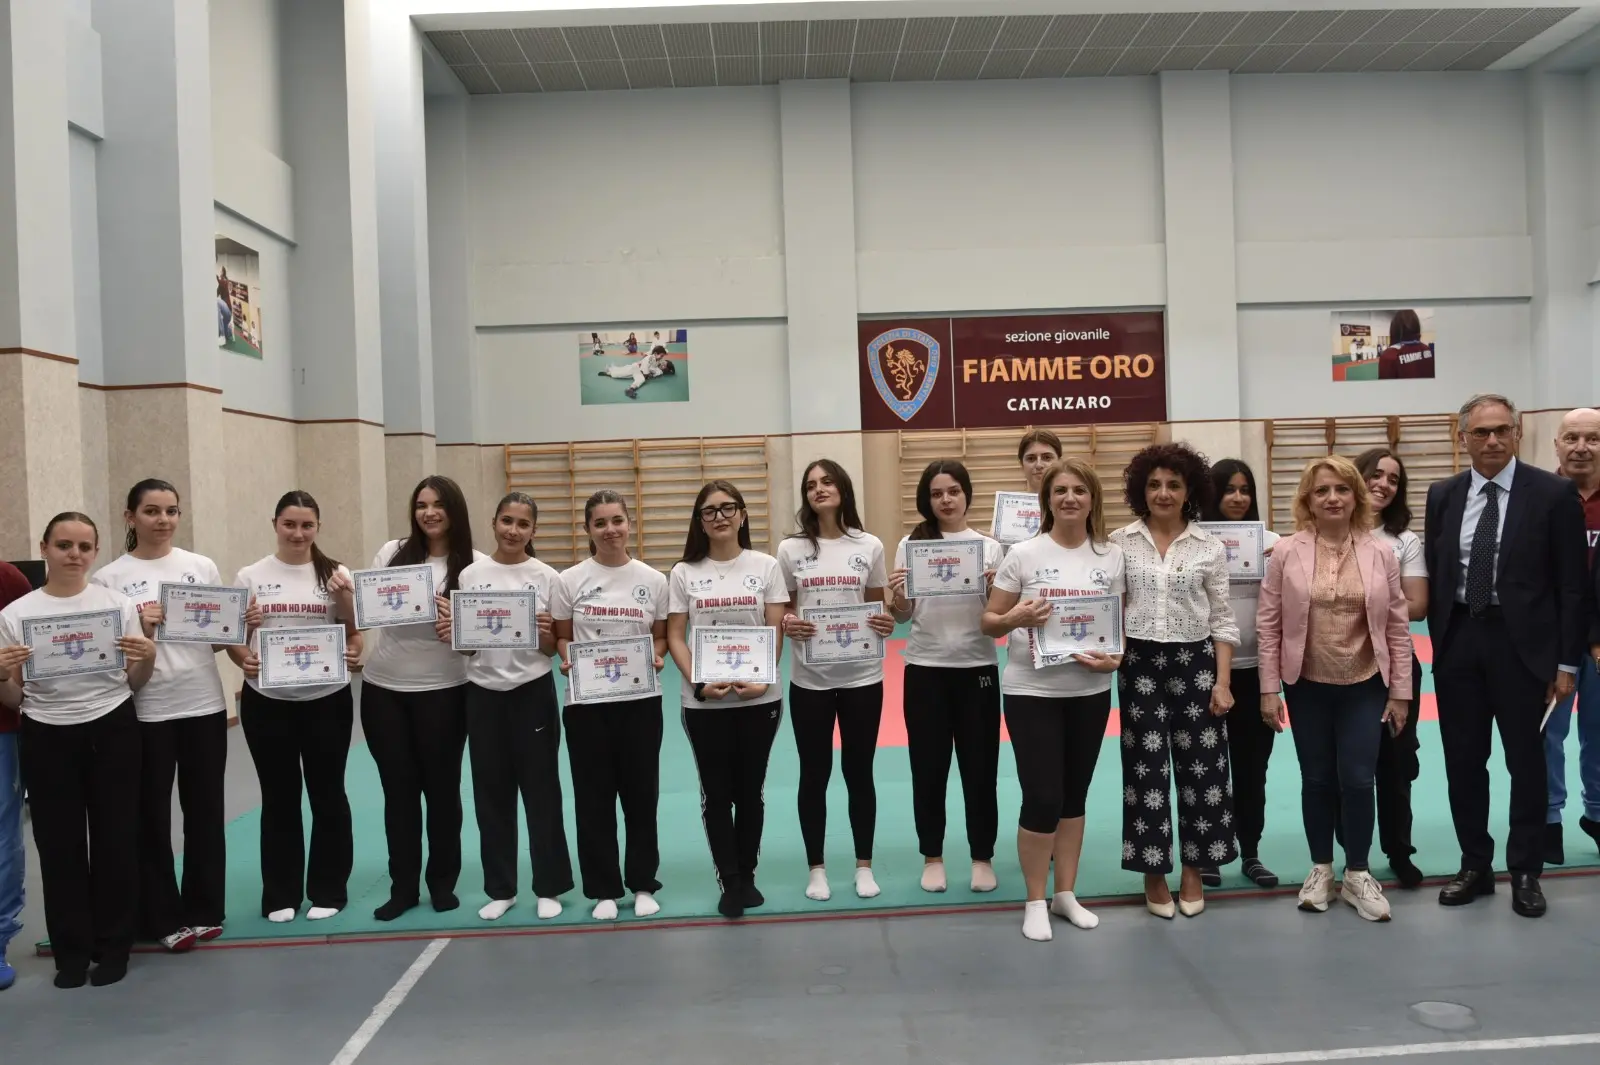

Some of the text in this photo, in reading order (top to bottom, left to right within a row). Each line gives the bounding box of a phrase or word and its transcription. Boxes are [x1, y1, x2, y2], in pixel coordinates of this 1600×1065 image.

[1005, 328, 1110, 344] sezione giovanile
[963, 354, 1155, 383] FIAMME ORO
[1007, 396, 1111, 411] CATANZARO
[810, 577, 825, 587] NON
[826, 576, 836, 585] HO
[837, 576, 861, 585] PAURA
[1040, 588, 1048, 597] IO
[1050, 589, 1066, 597] NON
[696, 596, 757, 609] IO NON HO PAURA
[263, 604, 327, 614] IO NON HO PAURA
[584, 607, 644, 618] IO NON HO PAURA
